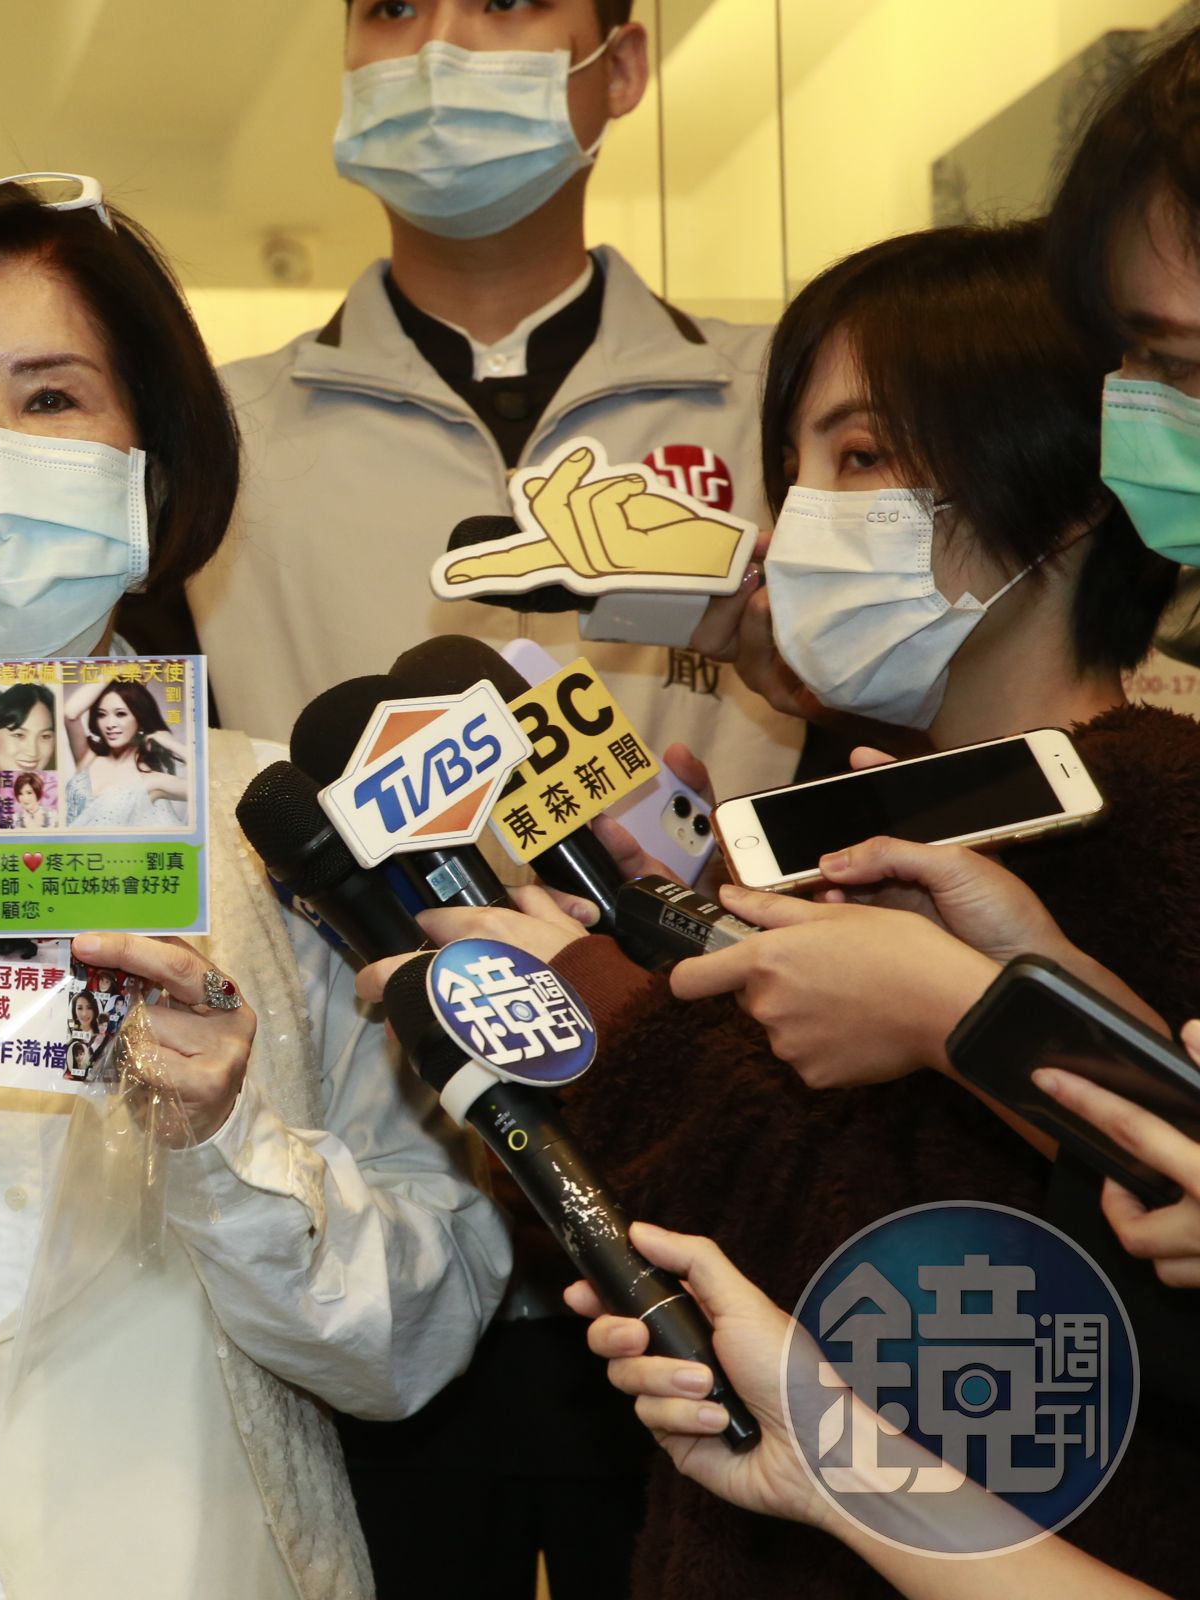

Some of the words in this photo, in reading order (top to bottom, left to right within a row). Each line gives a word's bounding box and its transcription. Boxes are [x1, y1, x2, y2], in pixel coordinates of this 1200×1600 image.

[866, 510, 899, 523] csd
[354, 713, 502, 834] TVBS
[499, 672, 614, 800] BC
[503, 733, 652, 850] 東森新聞
